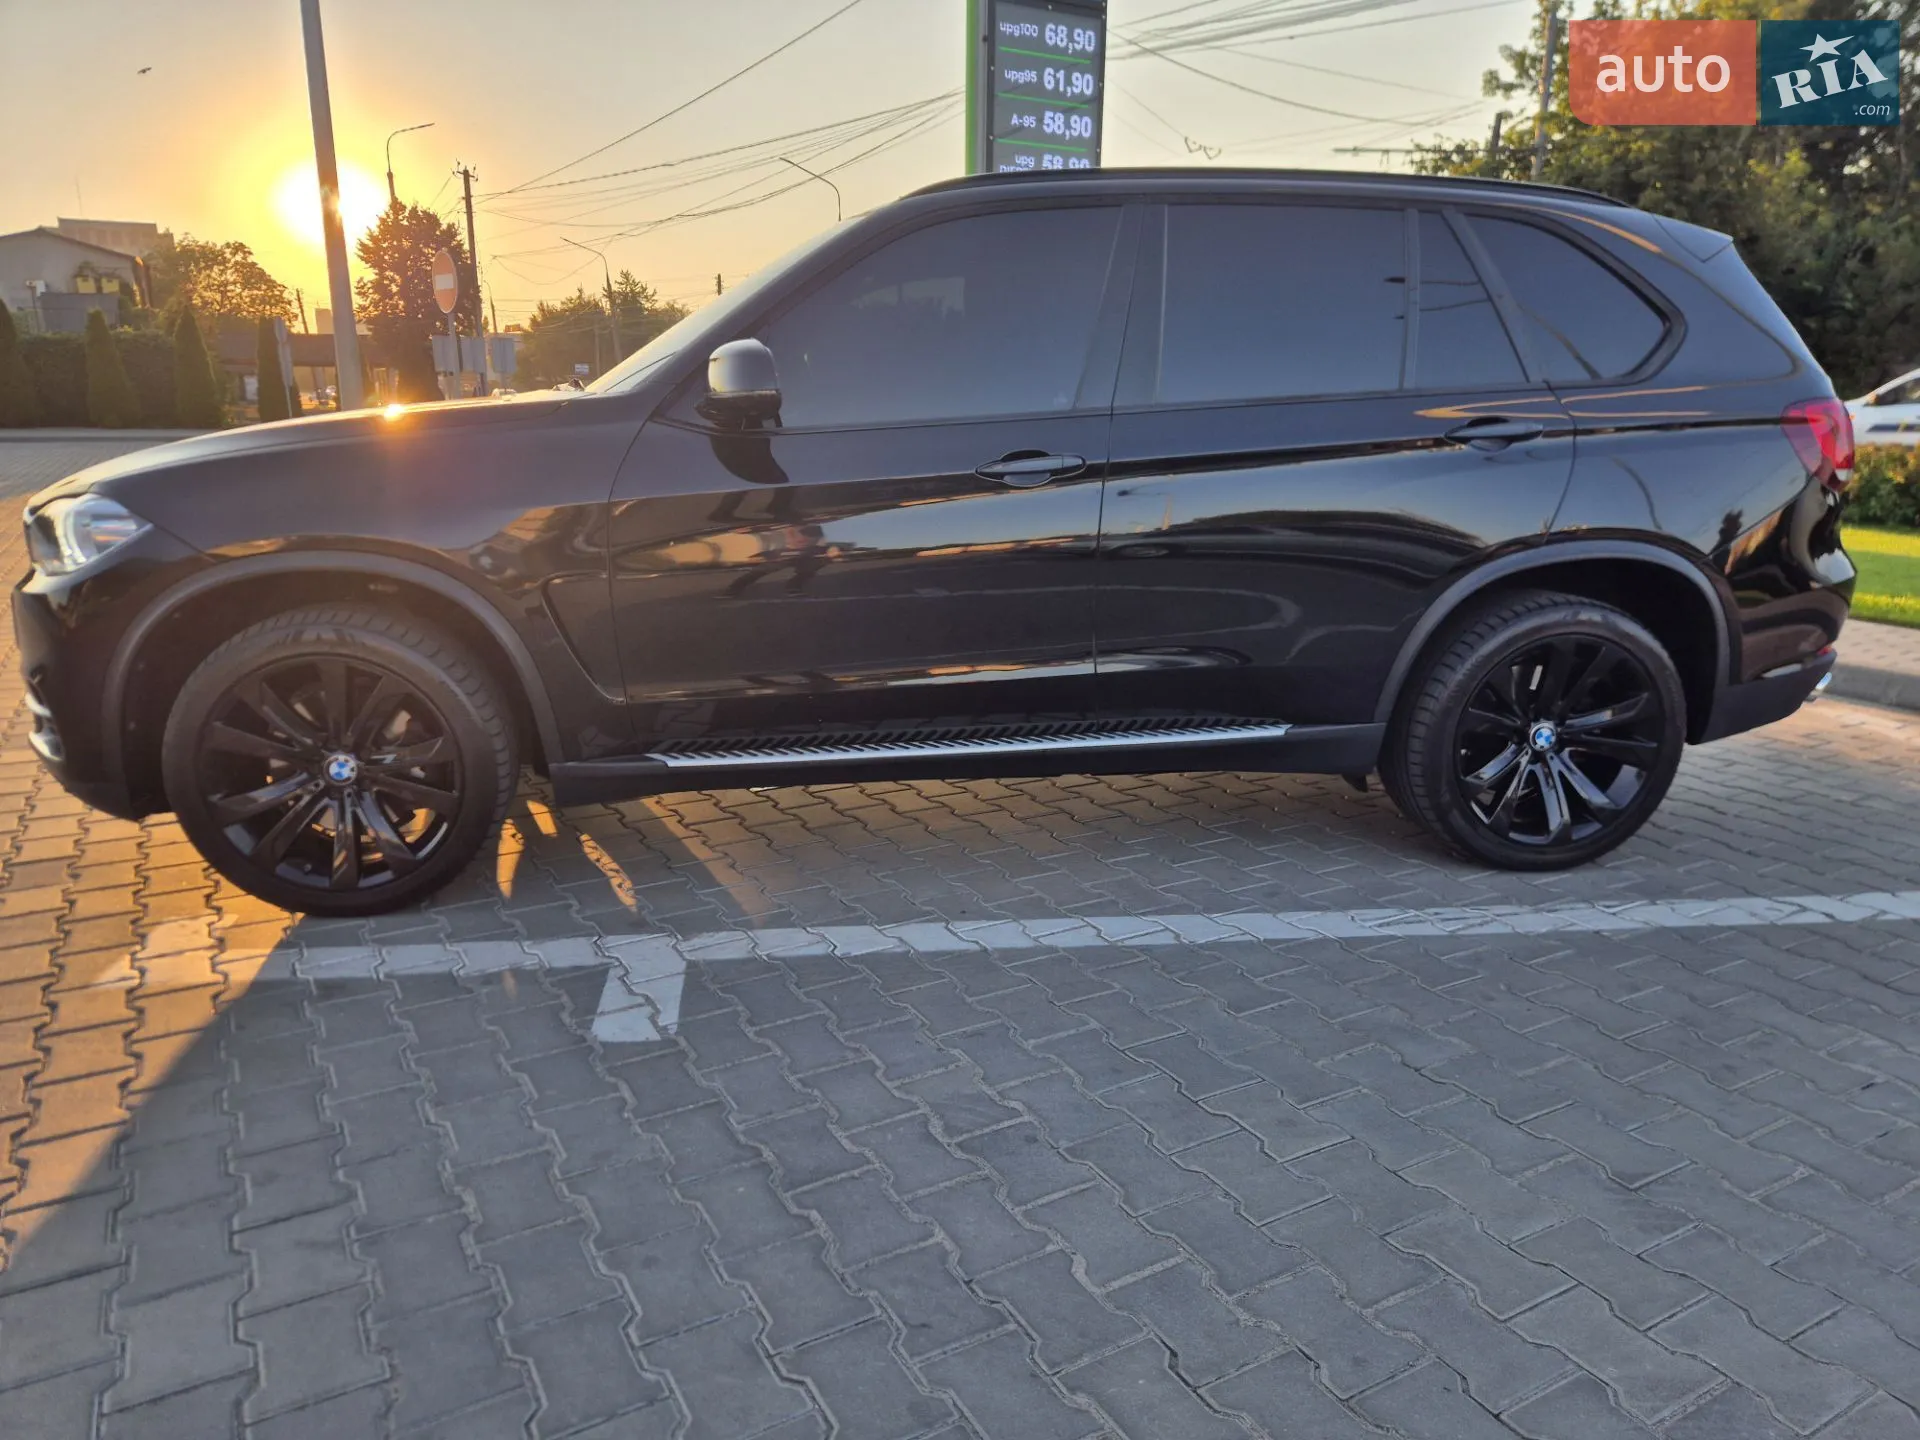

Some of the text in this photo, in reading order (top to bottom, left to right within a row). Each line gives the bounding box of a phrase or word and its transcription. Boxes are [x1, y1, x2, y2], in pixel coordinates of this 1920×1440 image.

[1000, 21, 1096, 53] upg100 68,90
[1004, 67, 1094, 97] upg95 61,90
[1011, 110, 1092, 140] A-95 58,90
[1015, 154, 1034, 168] upg
